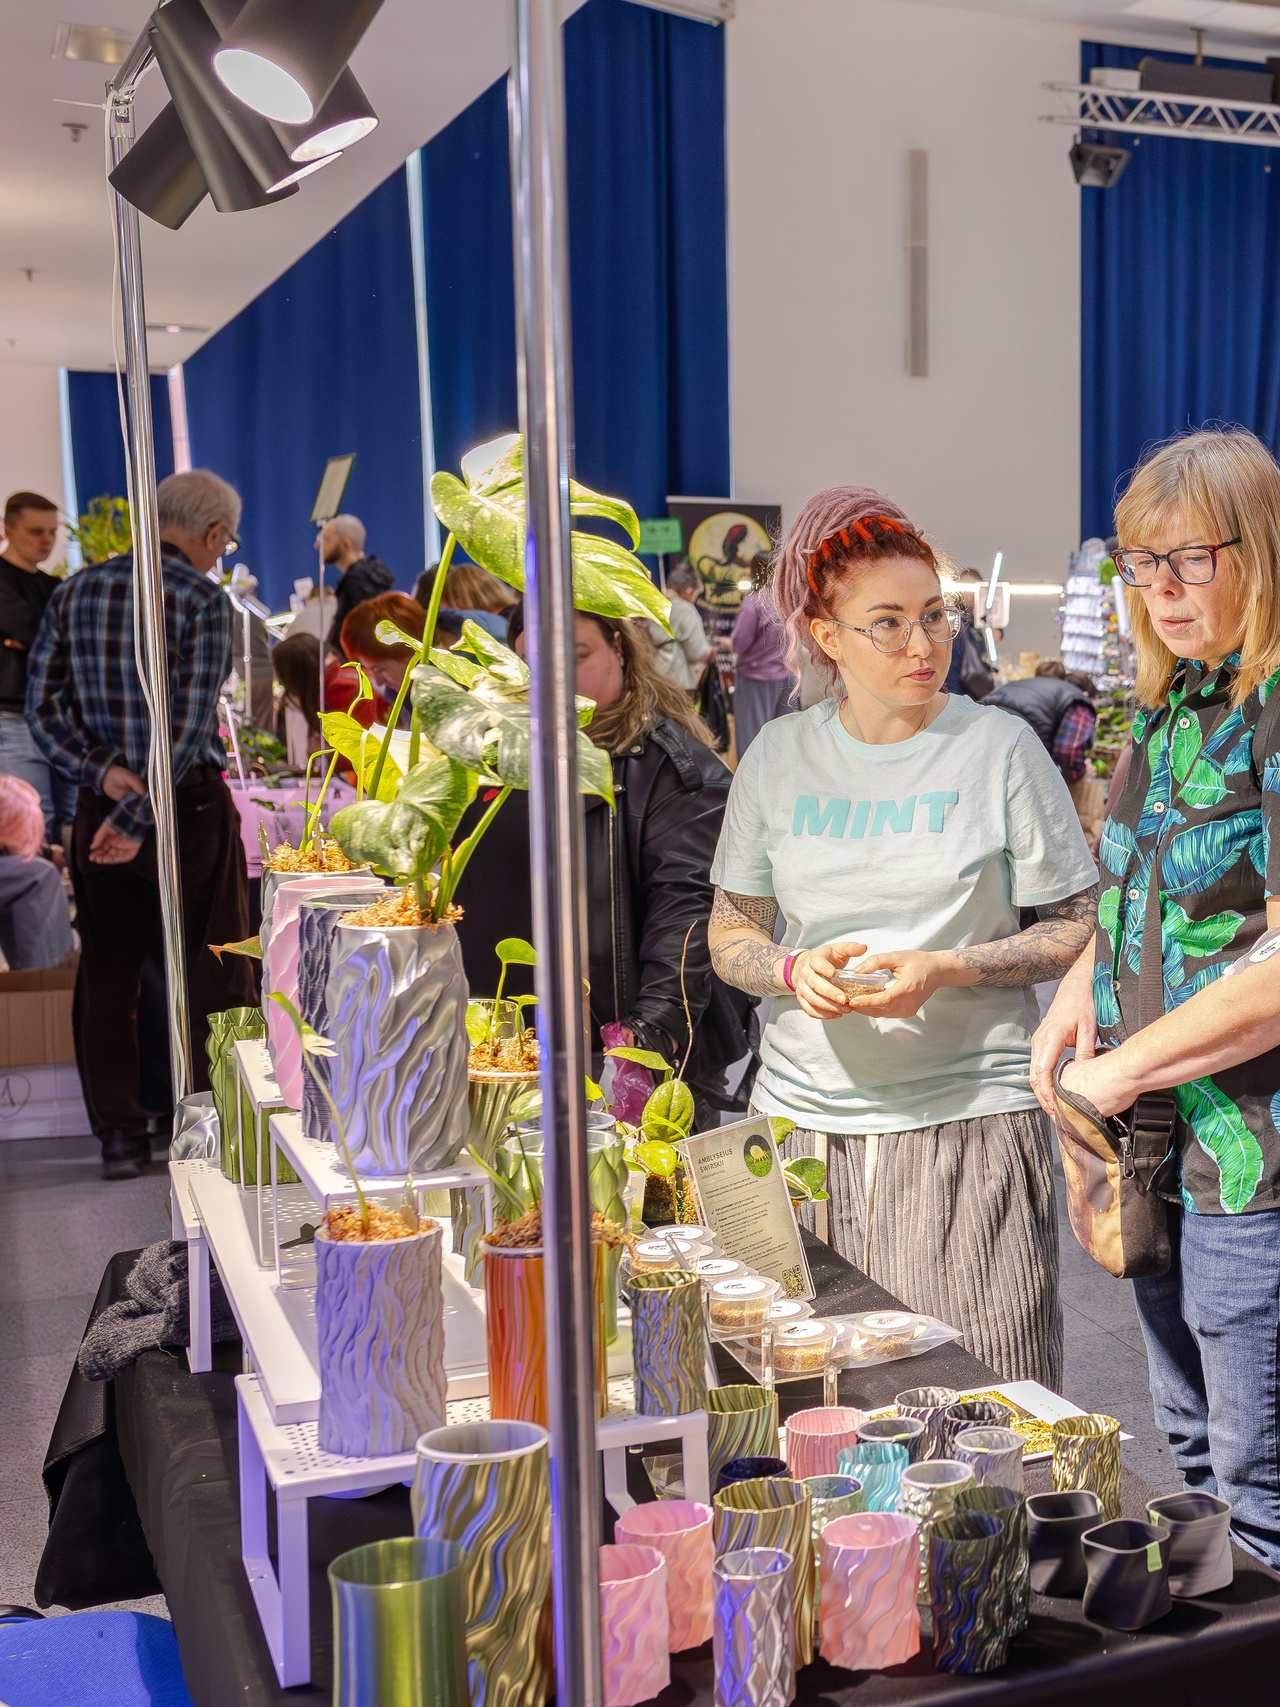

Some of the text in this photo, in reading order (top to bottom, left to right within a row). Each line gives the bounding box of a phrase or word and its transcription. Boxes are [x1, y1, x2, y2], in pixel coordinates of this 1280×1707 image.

[793, 790, 959, 839] MINT
[697, 1148, 733, 1165] AMBLYSEIUS
[699, 1161, 725, 1174] SWIRSKII
